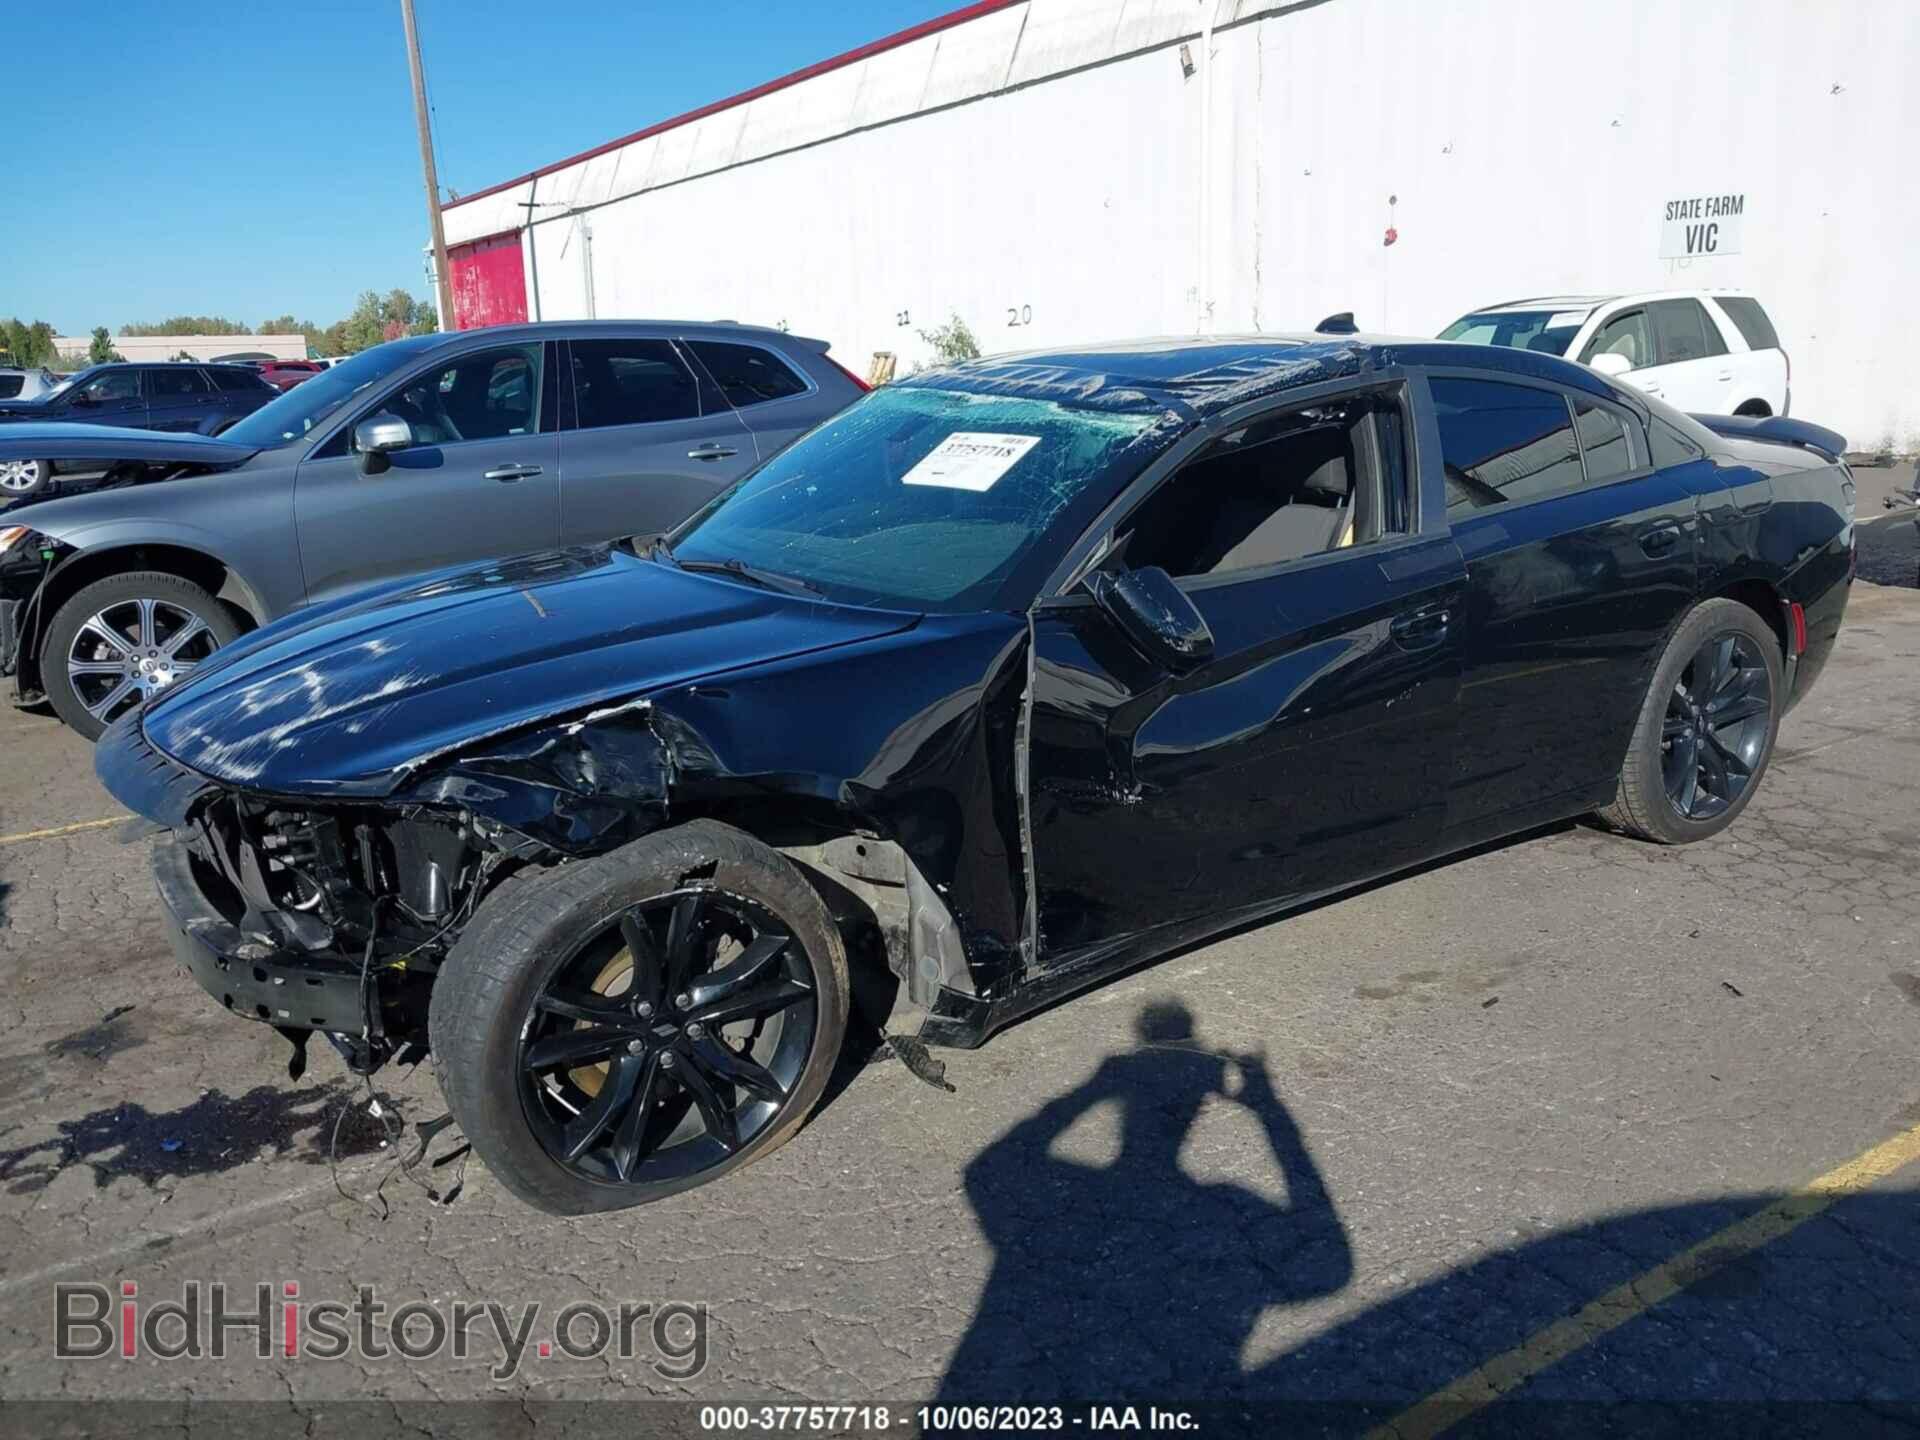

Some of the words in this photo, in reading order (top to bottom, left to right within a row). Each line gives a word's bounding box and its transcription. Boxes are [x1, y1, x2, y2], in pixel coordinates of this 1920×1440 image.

[1665, 198, 1702, 221] STATE
[1705, 194, 1745, 218] FARM
[1685, 222, 1719, 254] VIC
[1007, 304, 1033, 327] 20
